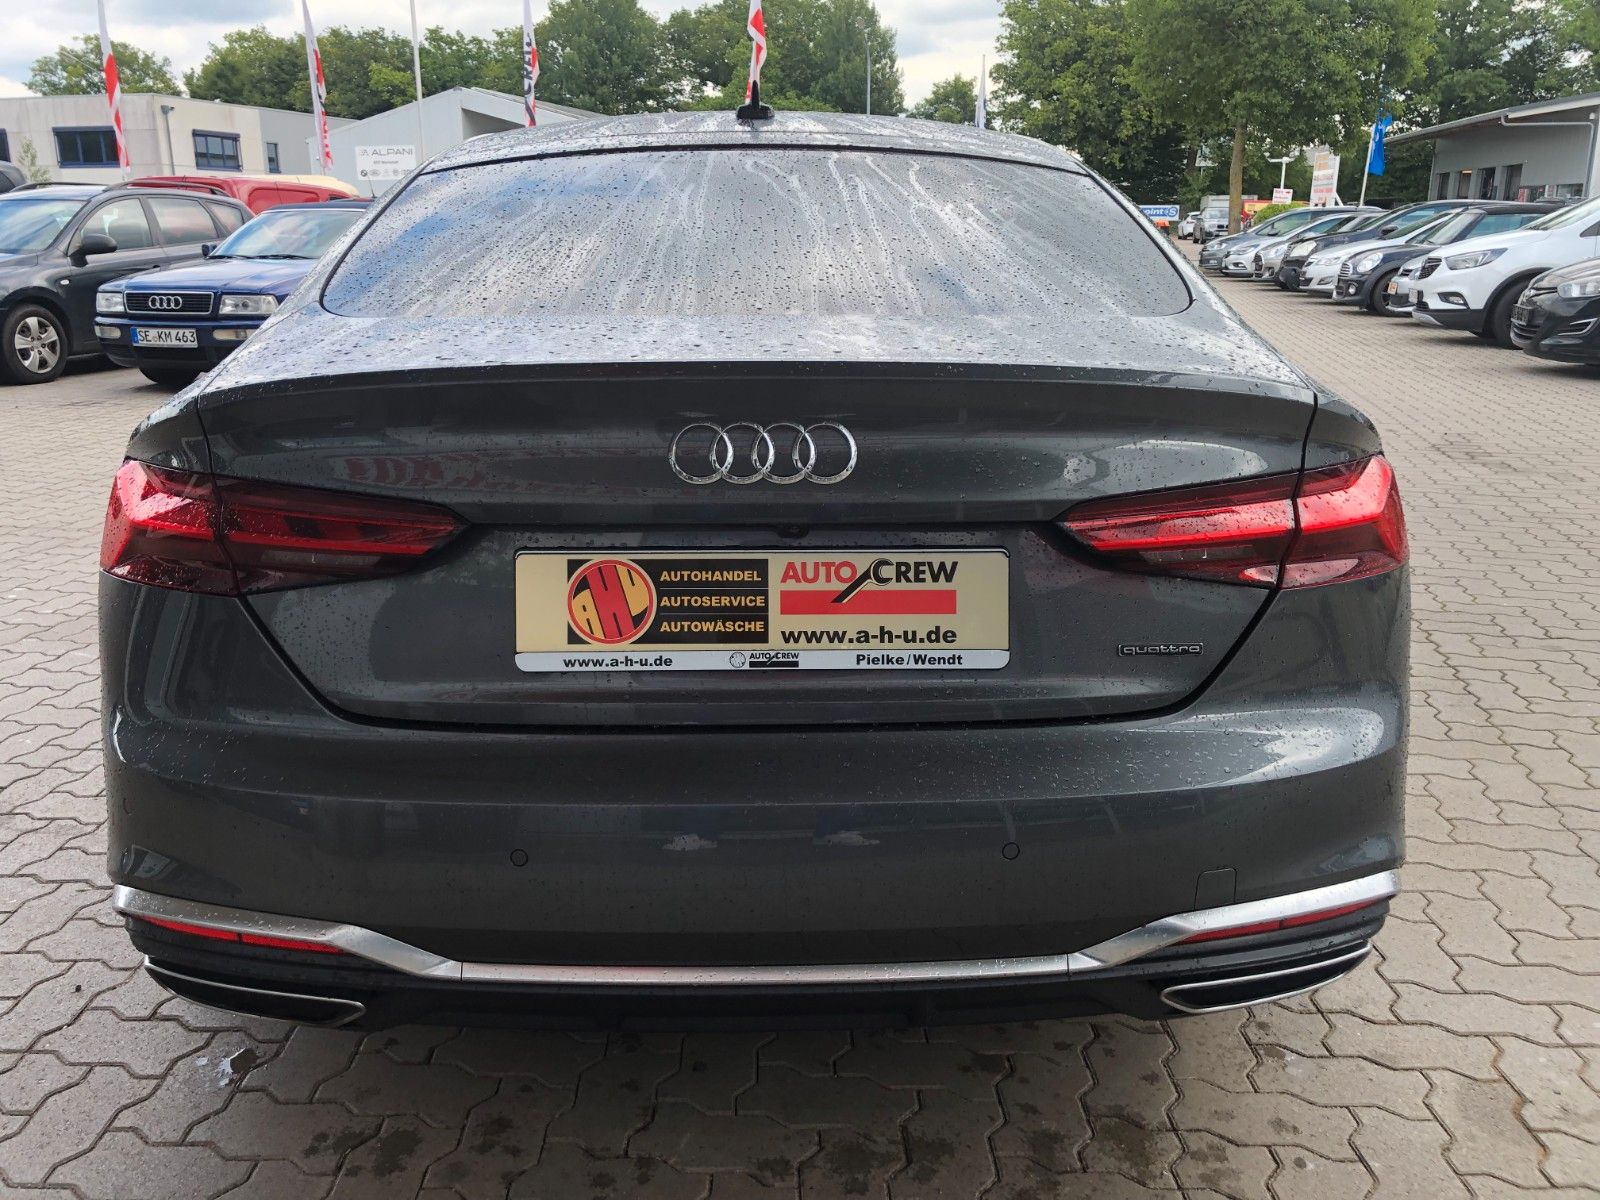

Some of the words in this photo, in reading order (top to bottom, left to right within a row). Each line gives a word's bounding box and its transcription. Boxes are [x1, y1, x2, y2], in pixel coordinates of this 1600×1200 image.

[371, 148, 413, 156] ALPANI
[138, 330, 152, 343] SE
[157, 330, 173, 343] KM
[175, 331, 196, 343] 463
[659, 570, 762, 582] AUTOHANDEL
[780, 560, 858, 584] AUTO
[871, 559, 959, 584] CREW
[659, 595, 766, 607] AUTOSERVICE
[660, 620, 765, 632] AUTOWÄSCHE
[780, 626, 957, 644] www.a-h-u.de
[1123, 645, 1200, 655] quattro
[563, 654, 674, 668] www.a-h-u.de
